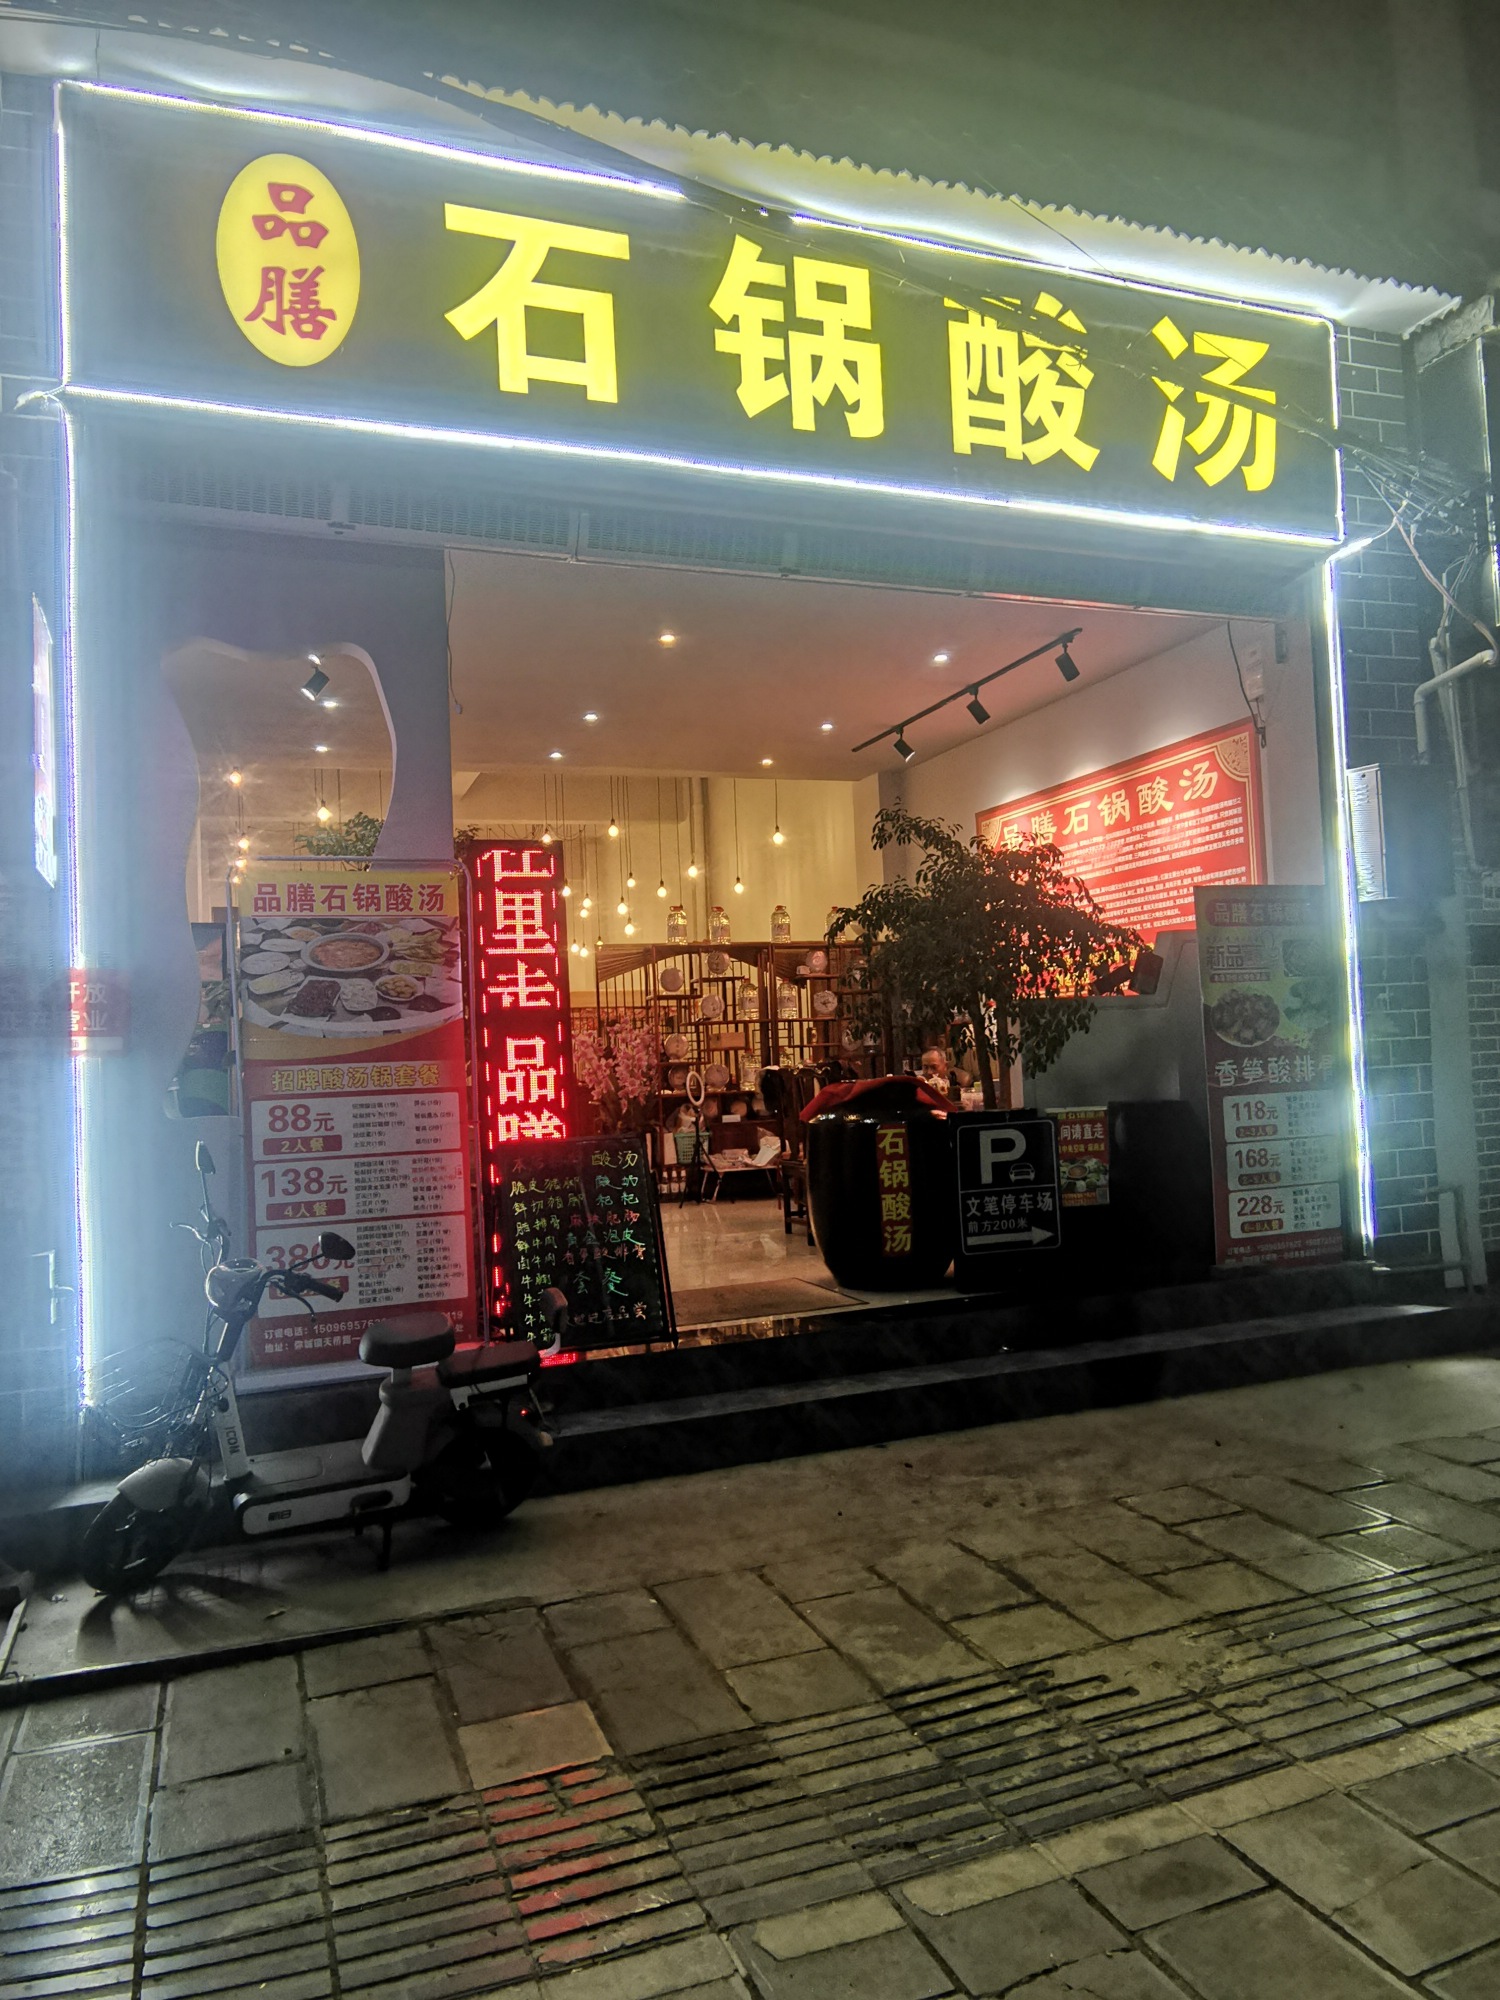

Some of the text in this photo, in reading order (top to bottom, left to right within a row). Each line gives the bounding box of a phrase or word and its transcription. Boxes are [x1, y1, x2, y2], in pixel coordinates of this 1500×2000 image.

[244, 182, 338, 341] 品膳
[444, 202, 1277, 492] 石锅酸汤
[1002, 761, 1218, 851] 品膳石锅酸汤
[253, 883, 445, 912] 品膳石锅酸汤
[271, 1064, 440, 1092] 招牌酸汤锅套餐
[268, 1104, 335, 1133] 88元
[1232, 1100, 1278, 1121] 118元
[280, 1138, 325, 1153] 2人餐
[979, 1129, 1027, 1184] P
[1235, 1148, 1281, 1169] 168元
[261, 1166, 348, 1197] 138元
[878, 1128, 912, 1252] 石锅酸汤
[283, 1201, 328, 1218] 4人餐
[966, 1192, 1053, 1217] 文笔停车场
[1237, 1195, 1285, 1217] 228元
[967, 1217, 1028, 1233] 前方200米
